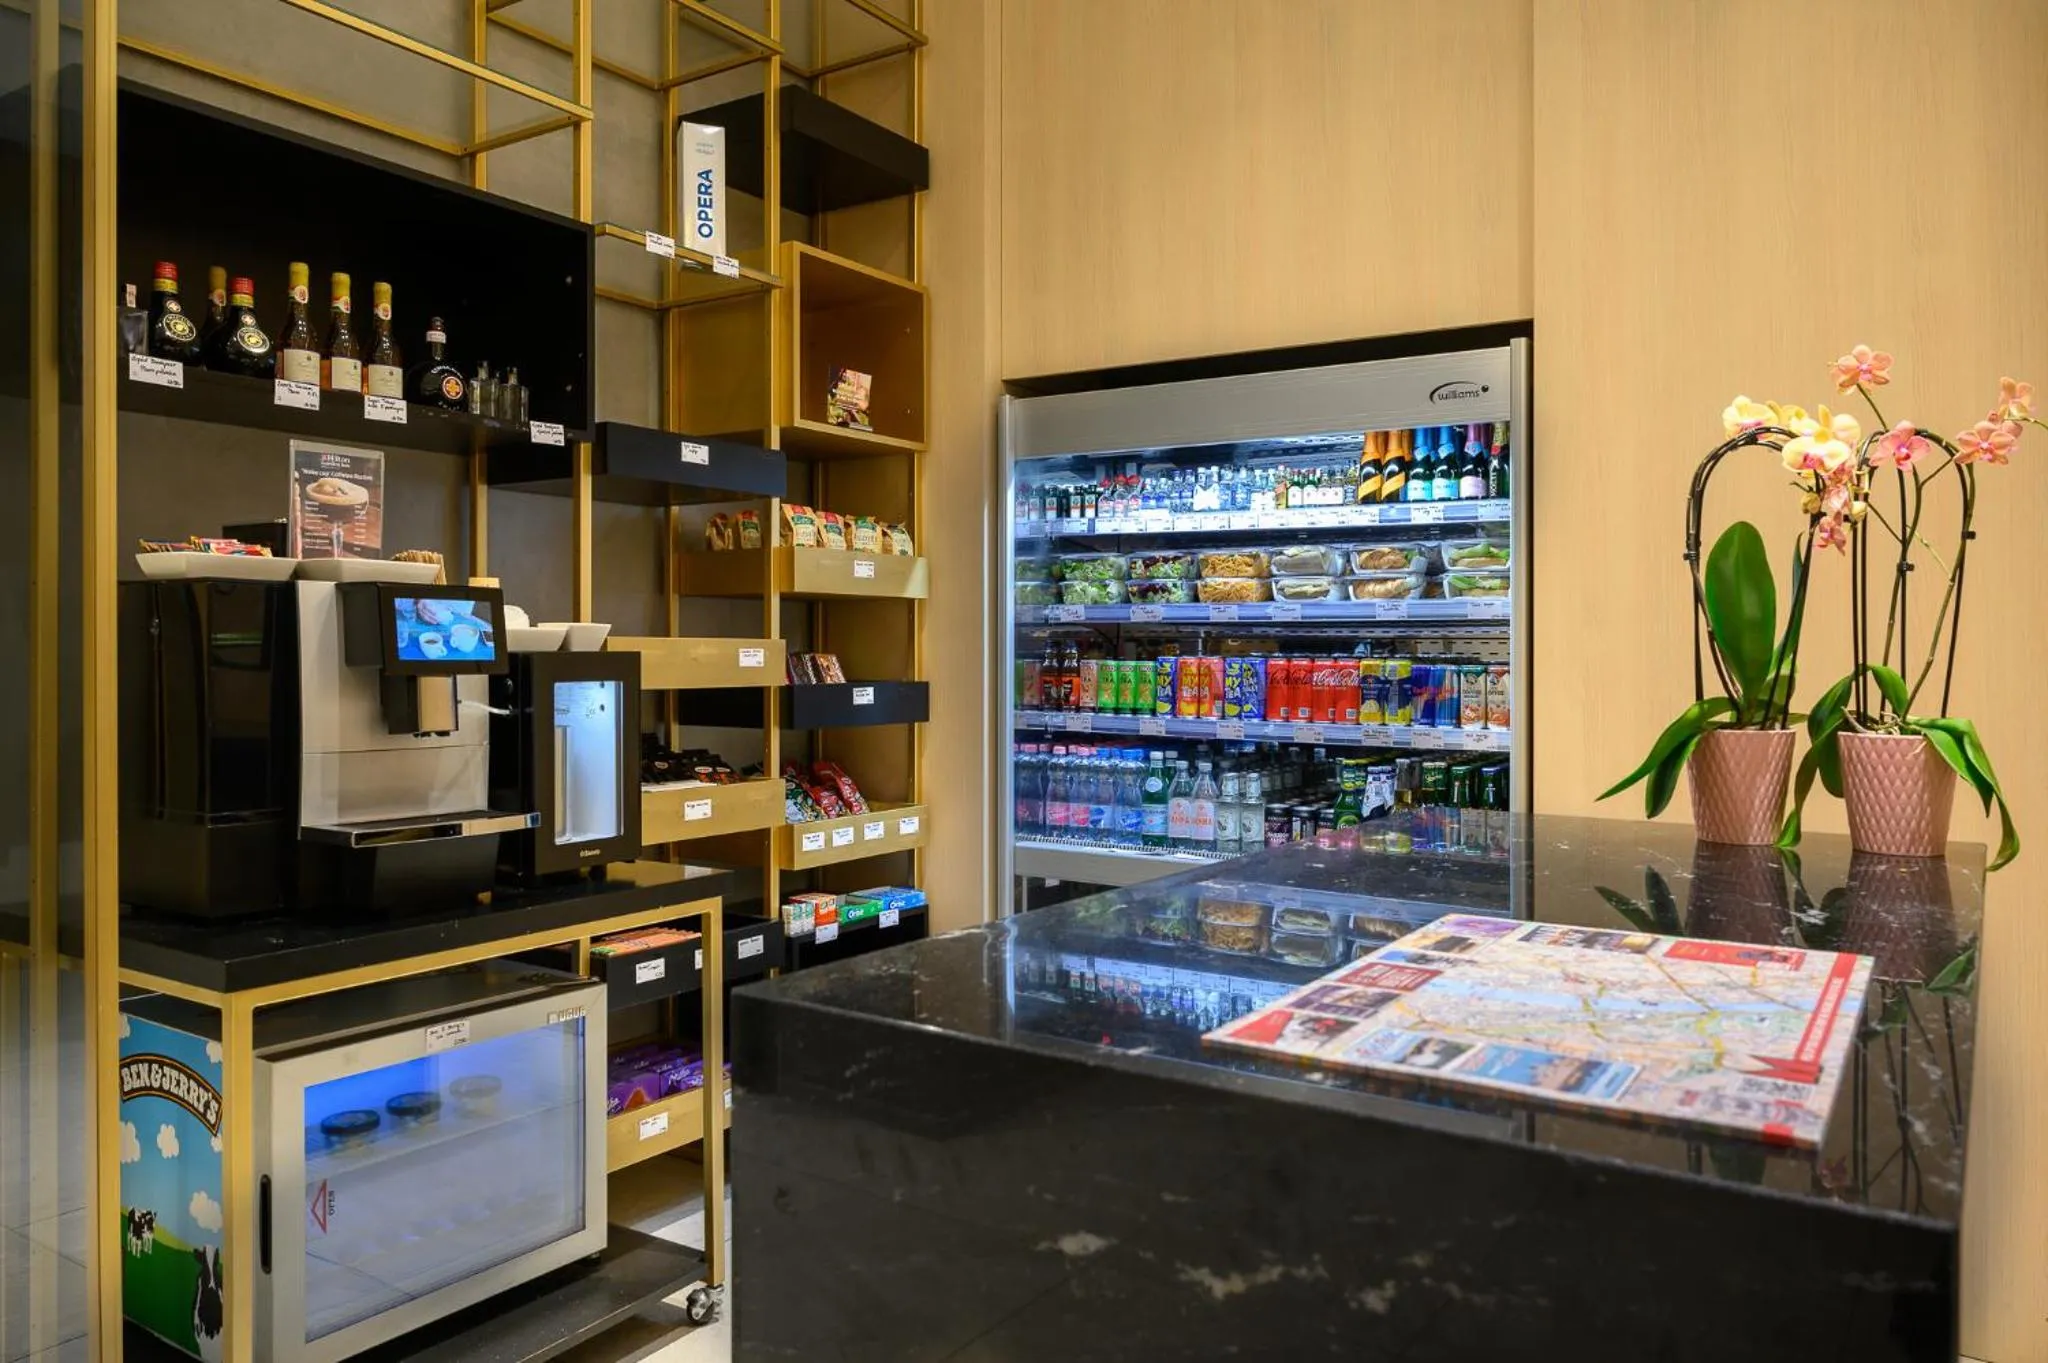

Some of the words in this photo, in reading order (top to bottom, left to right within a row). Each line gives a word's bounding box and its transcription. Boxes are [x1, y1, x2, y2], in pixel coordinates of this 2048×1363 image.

[697, 169, 713, 239] OPERA
[847, 908, 864, 919] Orbit
[668, 1068, 691, 1086] Milka
